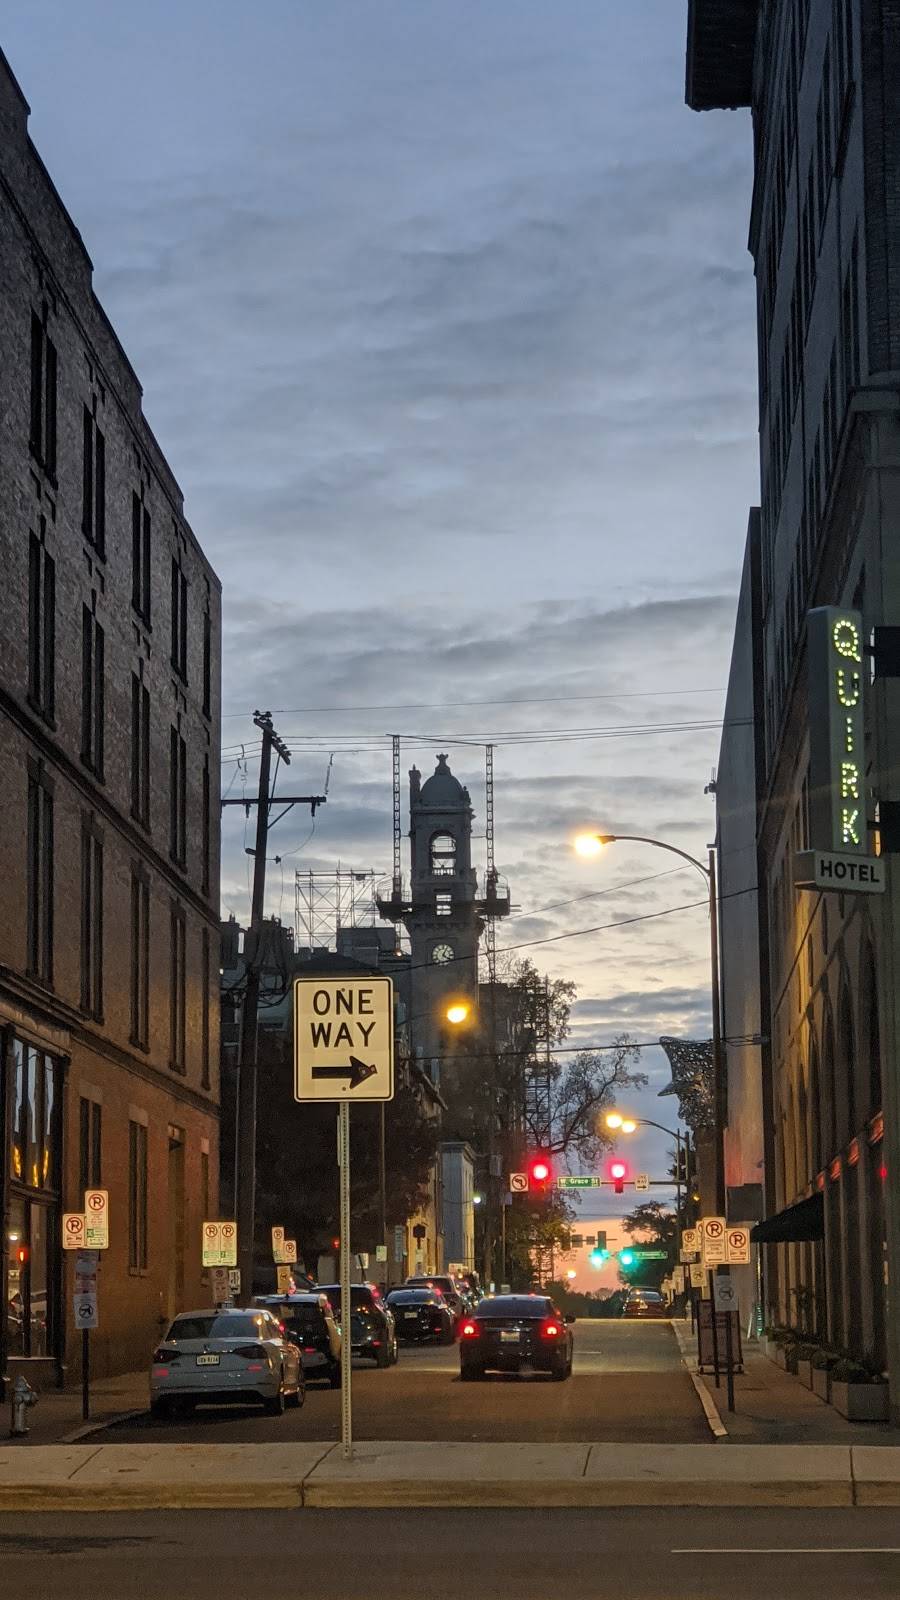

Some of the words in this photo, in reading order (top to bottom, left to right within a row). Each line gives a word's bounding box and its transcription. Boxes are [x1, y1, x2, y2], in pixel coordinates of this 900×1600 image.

[833, 620, 861, 844] QUIRK
[820, 859, 880, 883] HOTEL
[312, 989, 374, 1016] ONE
[310, 1021, 376, 1048] WAY
